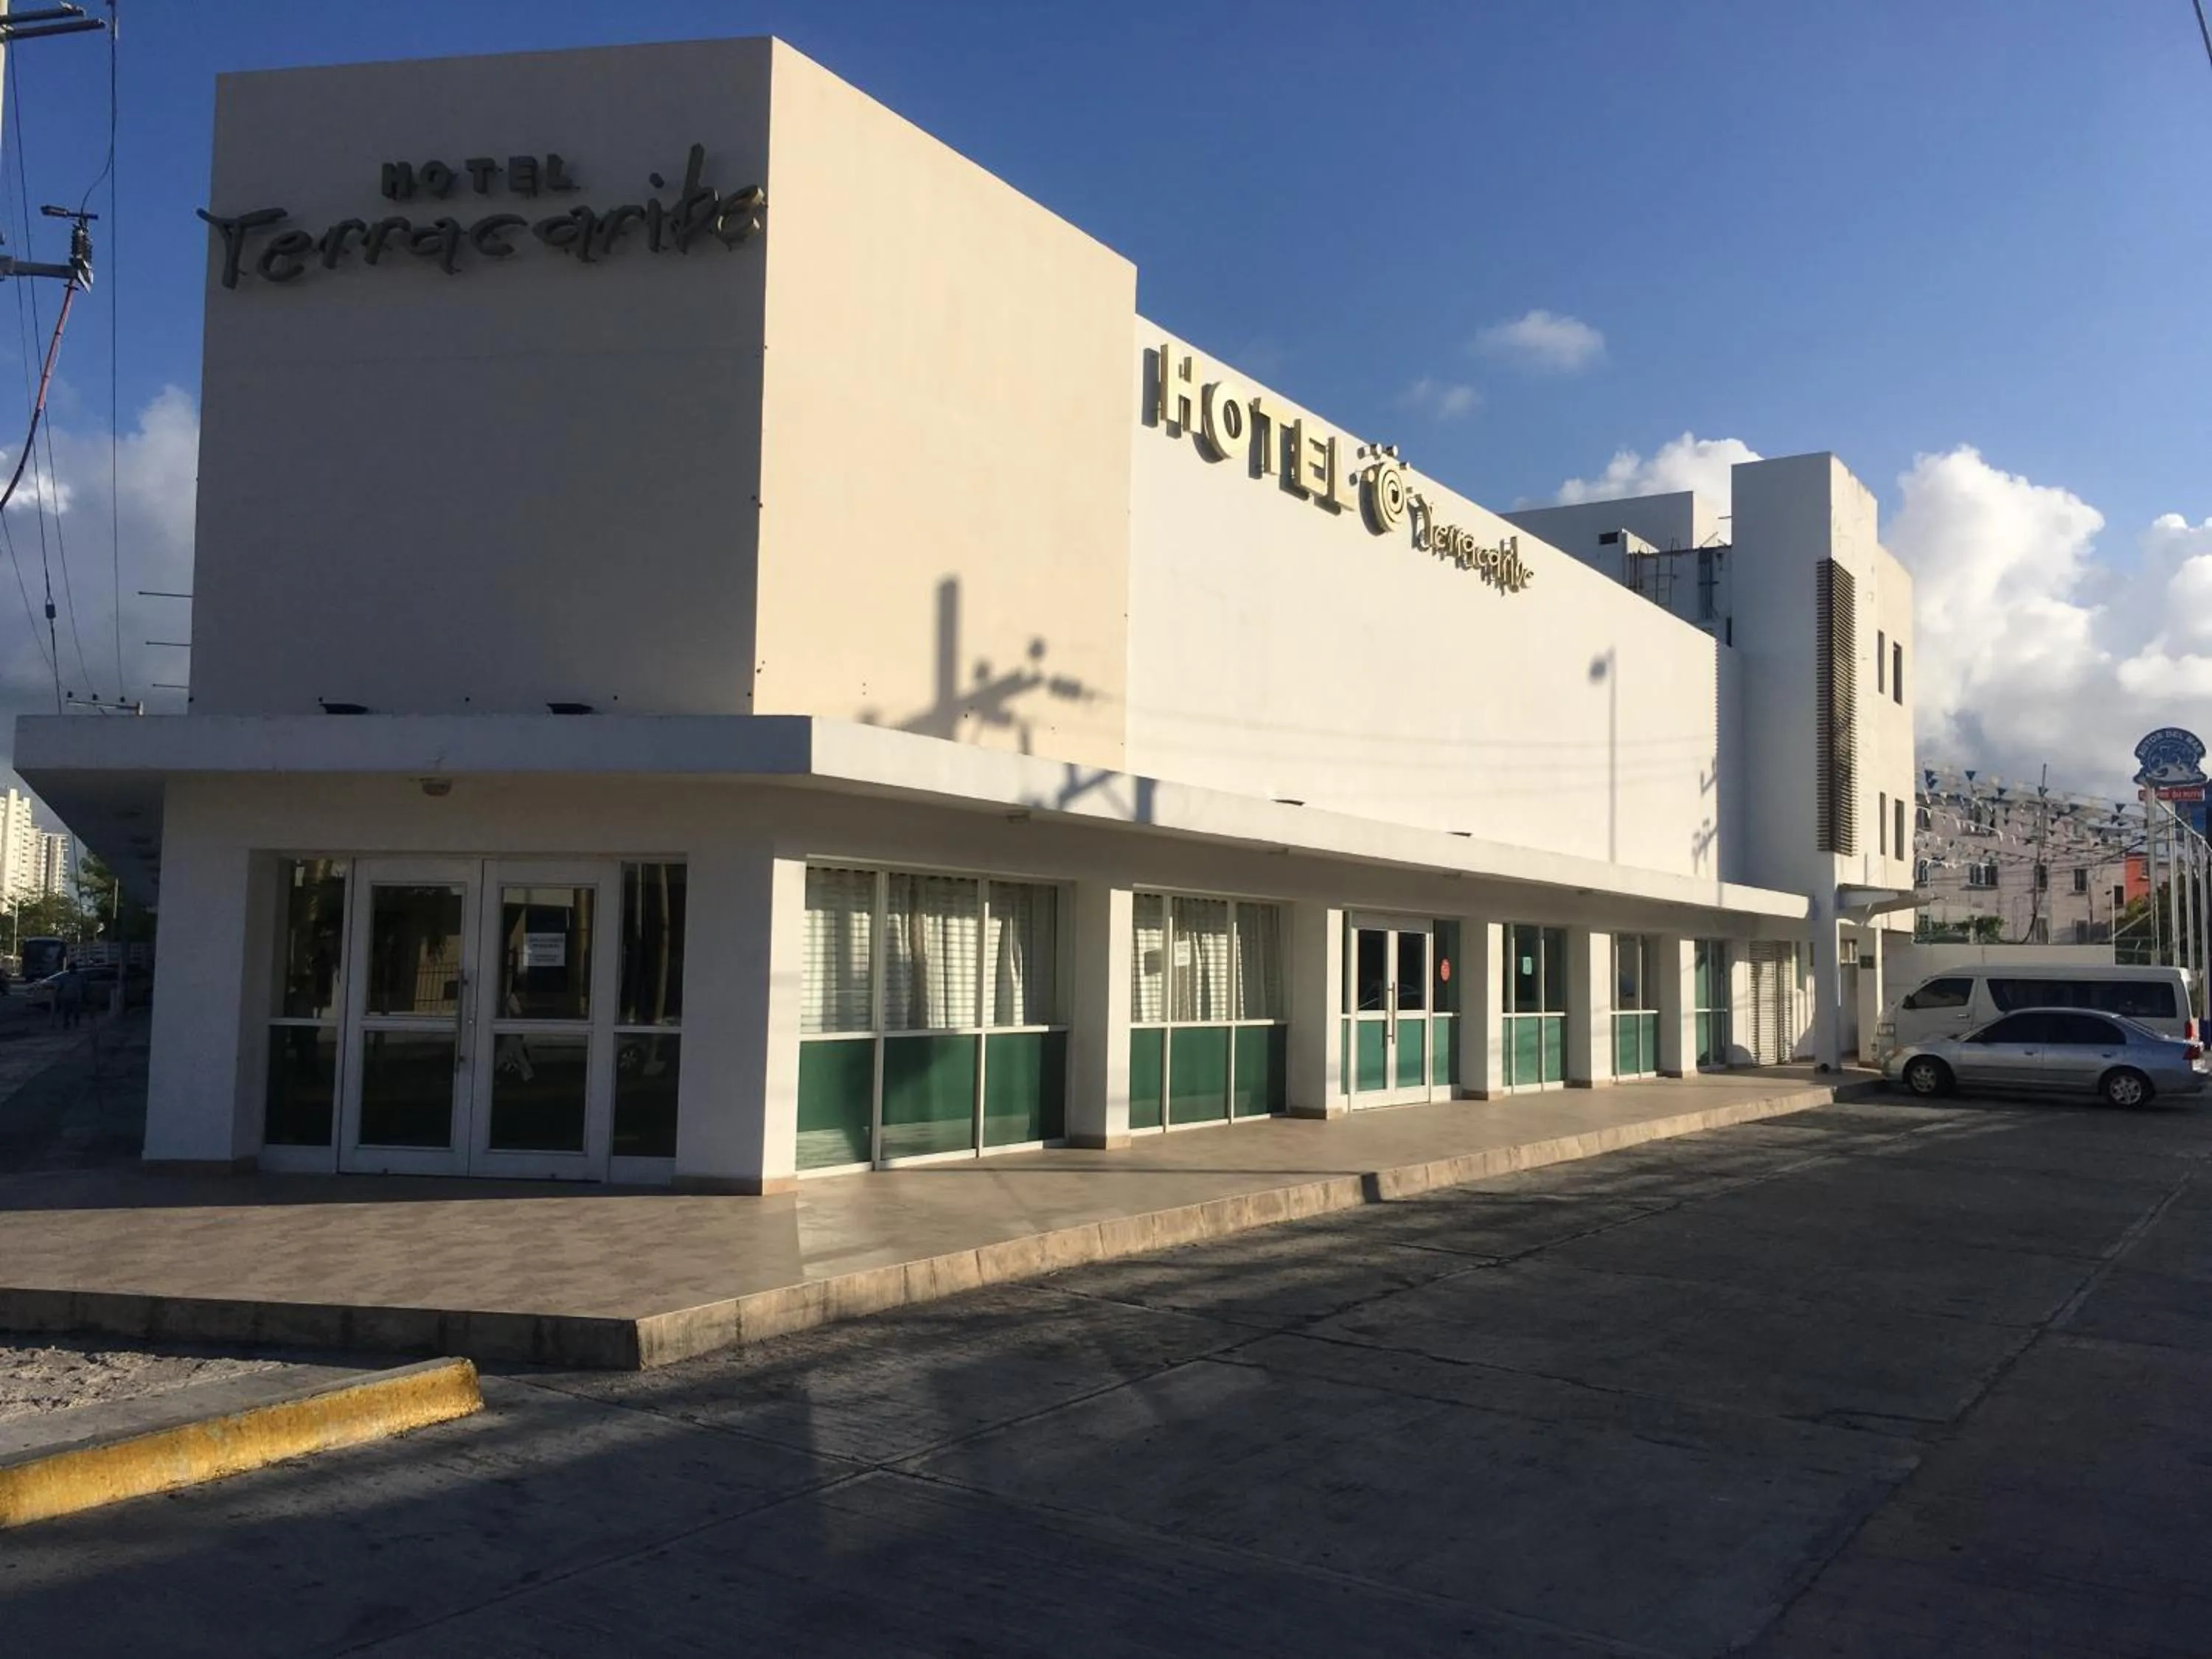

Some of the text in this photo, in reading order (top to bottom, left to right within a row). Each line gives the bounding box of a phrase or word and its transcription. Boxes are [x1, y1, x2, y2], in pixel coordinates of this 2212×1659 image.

[196, 144, 768, 289] Terracaribe
[380, 153, 580, 201] HOTEL
[1159, 343, 1358, 512] HOTEL
